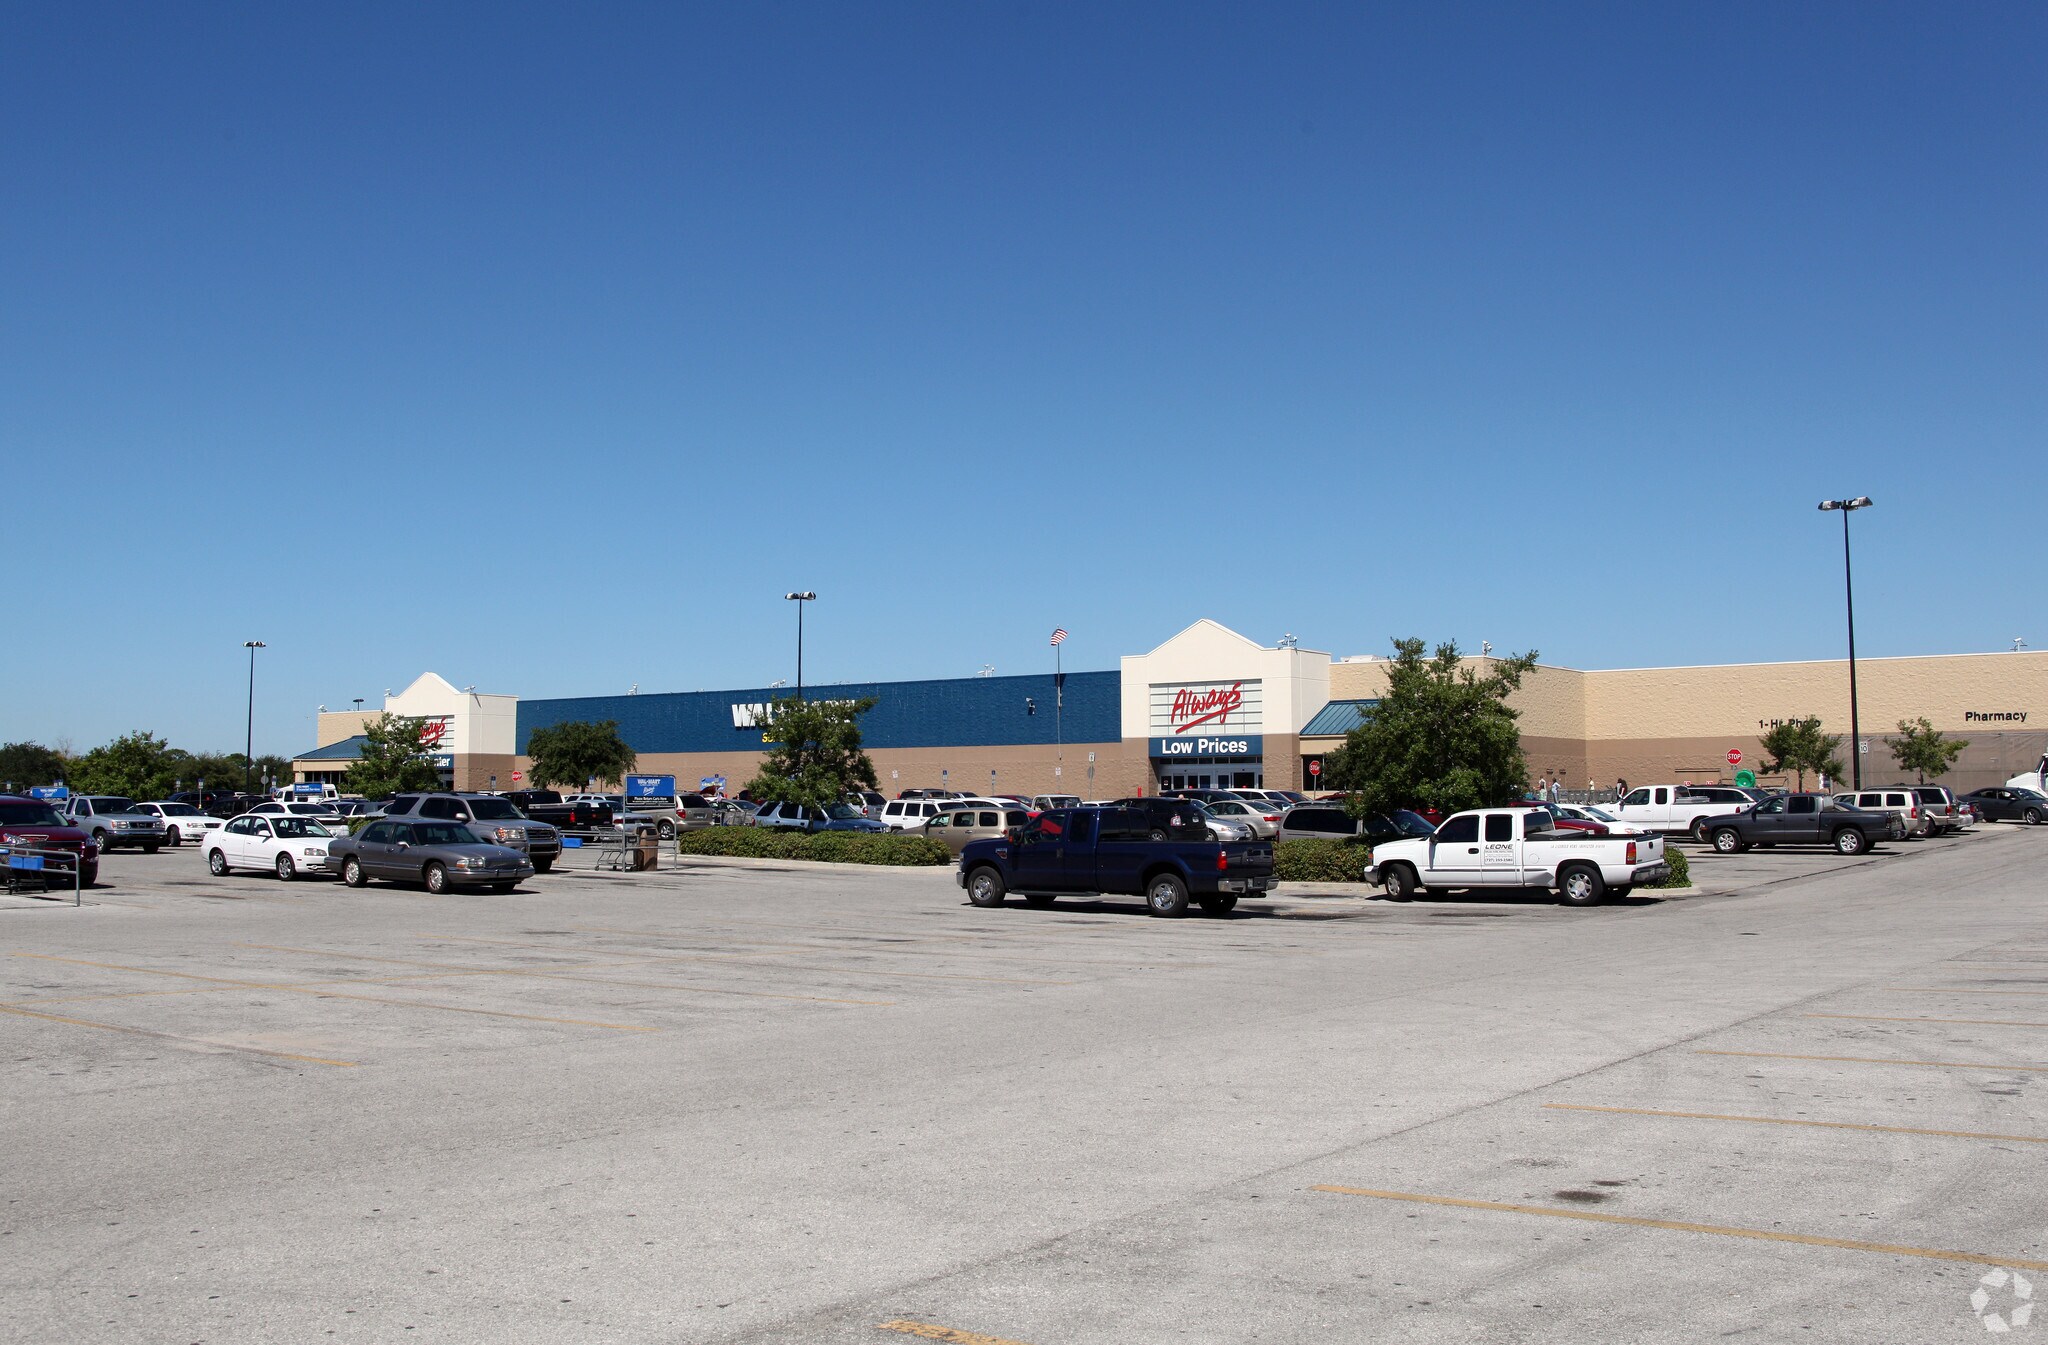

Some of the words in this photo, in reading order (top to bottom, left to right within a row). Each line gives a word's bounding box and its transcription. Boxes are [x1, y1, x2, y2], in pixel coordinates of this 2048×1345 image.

[1170, 681, 1242, 725] Always
[1965, 711, 2027, 722] Pharmacy
[1162, 739, 1194, 754] Low
[1198, 738, 1248, 754] Prices
